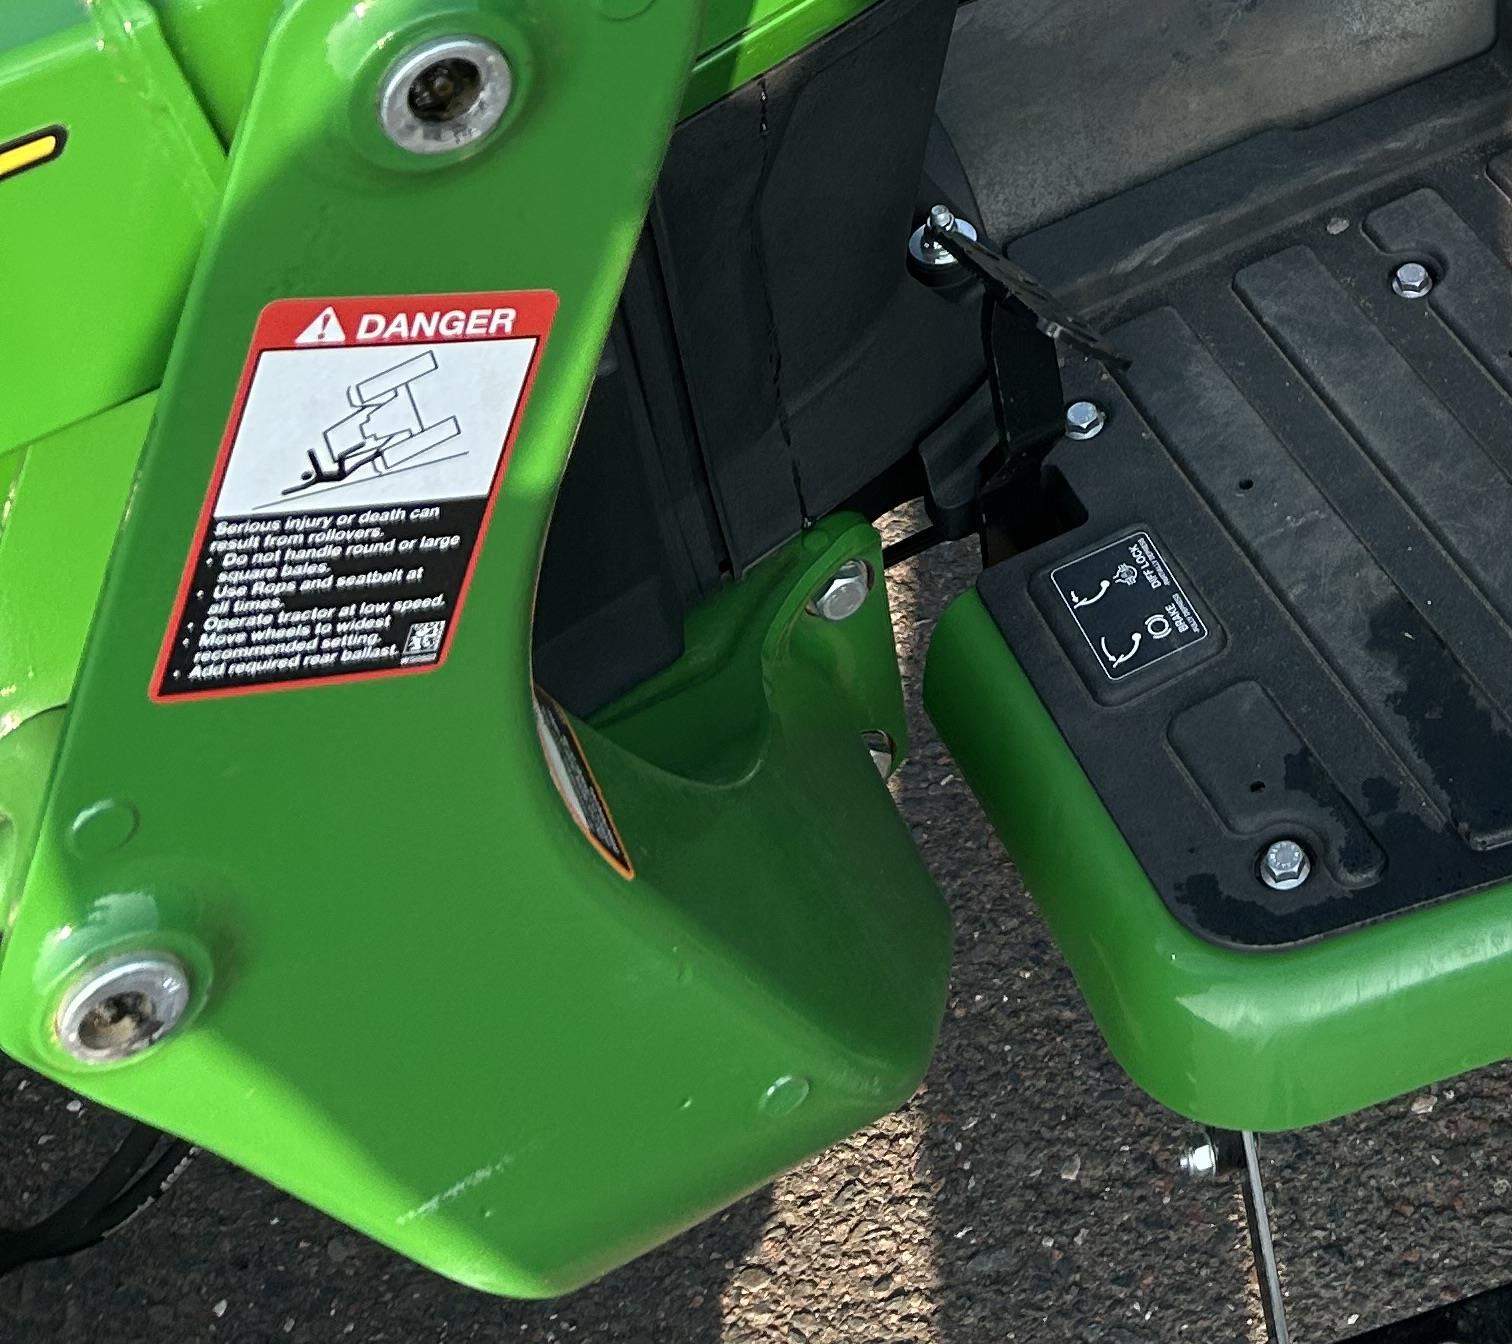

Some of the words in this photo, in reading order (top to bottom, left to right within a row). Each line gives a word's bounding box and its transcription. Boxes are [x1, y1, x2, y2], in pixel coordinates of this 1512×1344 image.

[356, 308, 517, 340] DANGER
[214, 520, 282, 536] Serious
[284, 516, 334, 531] injury
[336, 514, 358, 526] or
[358, 508, 406, 524] death
[409, 506, 441, 518] can
[209, 536, 260, 552] result
[263, 533, 305, 548] from
[307, 527, 384, 544] rollovers.
[222, 552, 249, 568] Do
[251, 550, 281, 565] not
[283, 544, 342, 561] handle
[345, 538, 396, 556] round
[397, 538, 418, 551] or
[419, 535, 461, 550] large
[1128, 543, 1150, 570] LOCK
[213, 584, 248, 600] Use
[251, 581, 297, 596] Rops
[299, 575, 334, 592] and
[336, 568, 404, 587] seatbelt
[405, 566, 424, 581] at
[216, 567, 278, 584] square
[281, 562, 332, 578] bales.
[1142, 569, 1162, 590] DIFF
[203, 613, 274, 632] Operate
[277, 607, 336, 625] tractor
[338, 603, 356, 617] at
[359, 601, 391, 614] low
[392, 593, 445, 613] speed.
[206, 599, 230, 615] all
[233, 597, 285, 612] times.
[1164, 602, 1190, 633] BRAKE
[198, 631, 247, 648] Move
[250, 625, 311, 644] wheels
[314, 622, 332, 635] to
[336, 614, 392, 633] widest
[187, 662, 227, 680] Add
[228, 654, 301, 678] required
[302, 651, 339, 666] rear
[340, 643, 400, 662] ballast.
[193, 637, 319, 663] recommended
[320, 632, 382, 651] setting.
